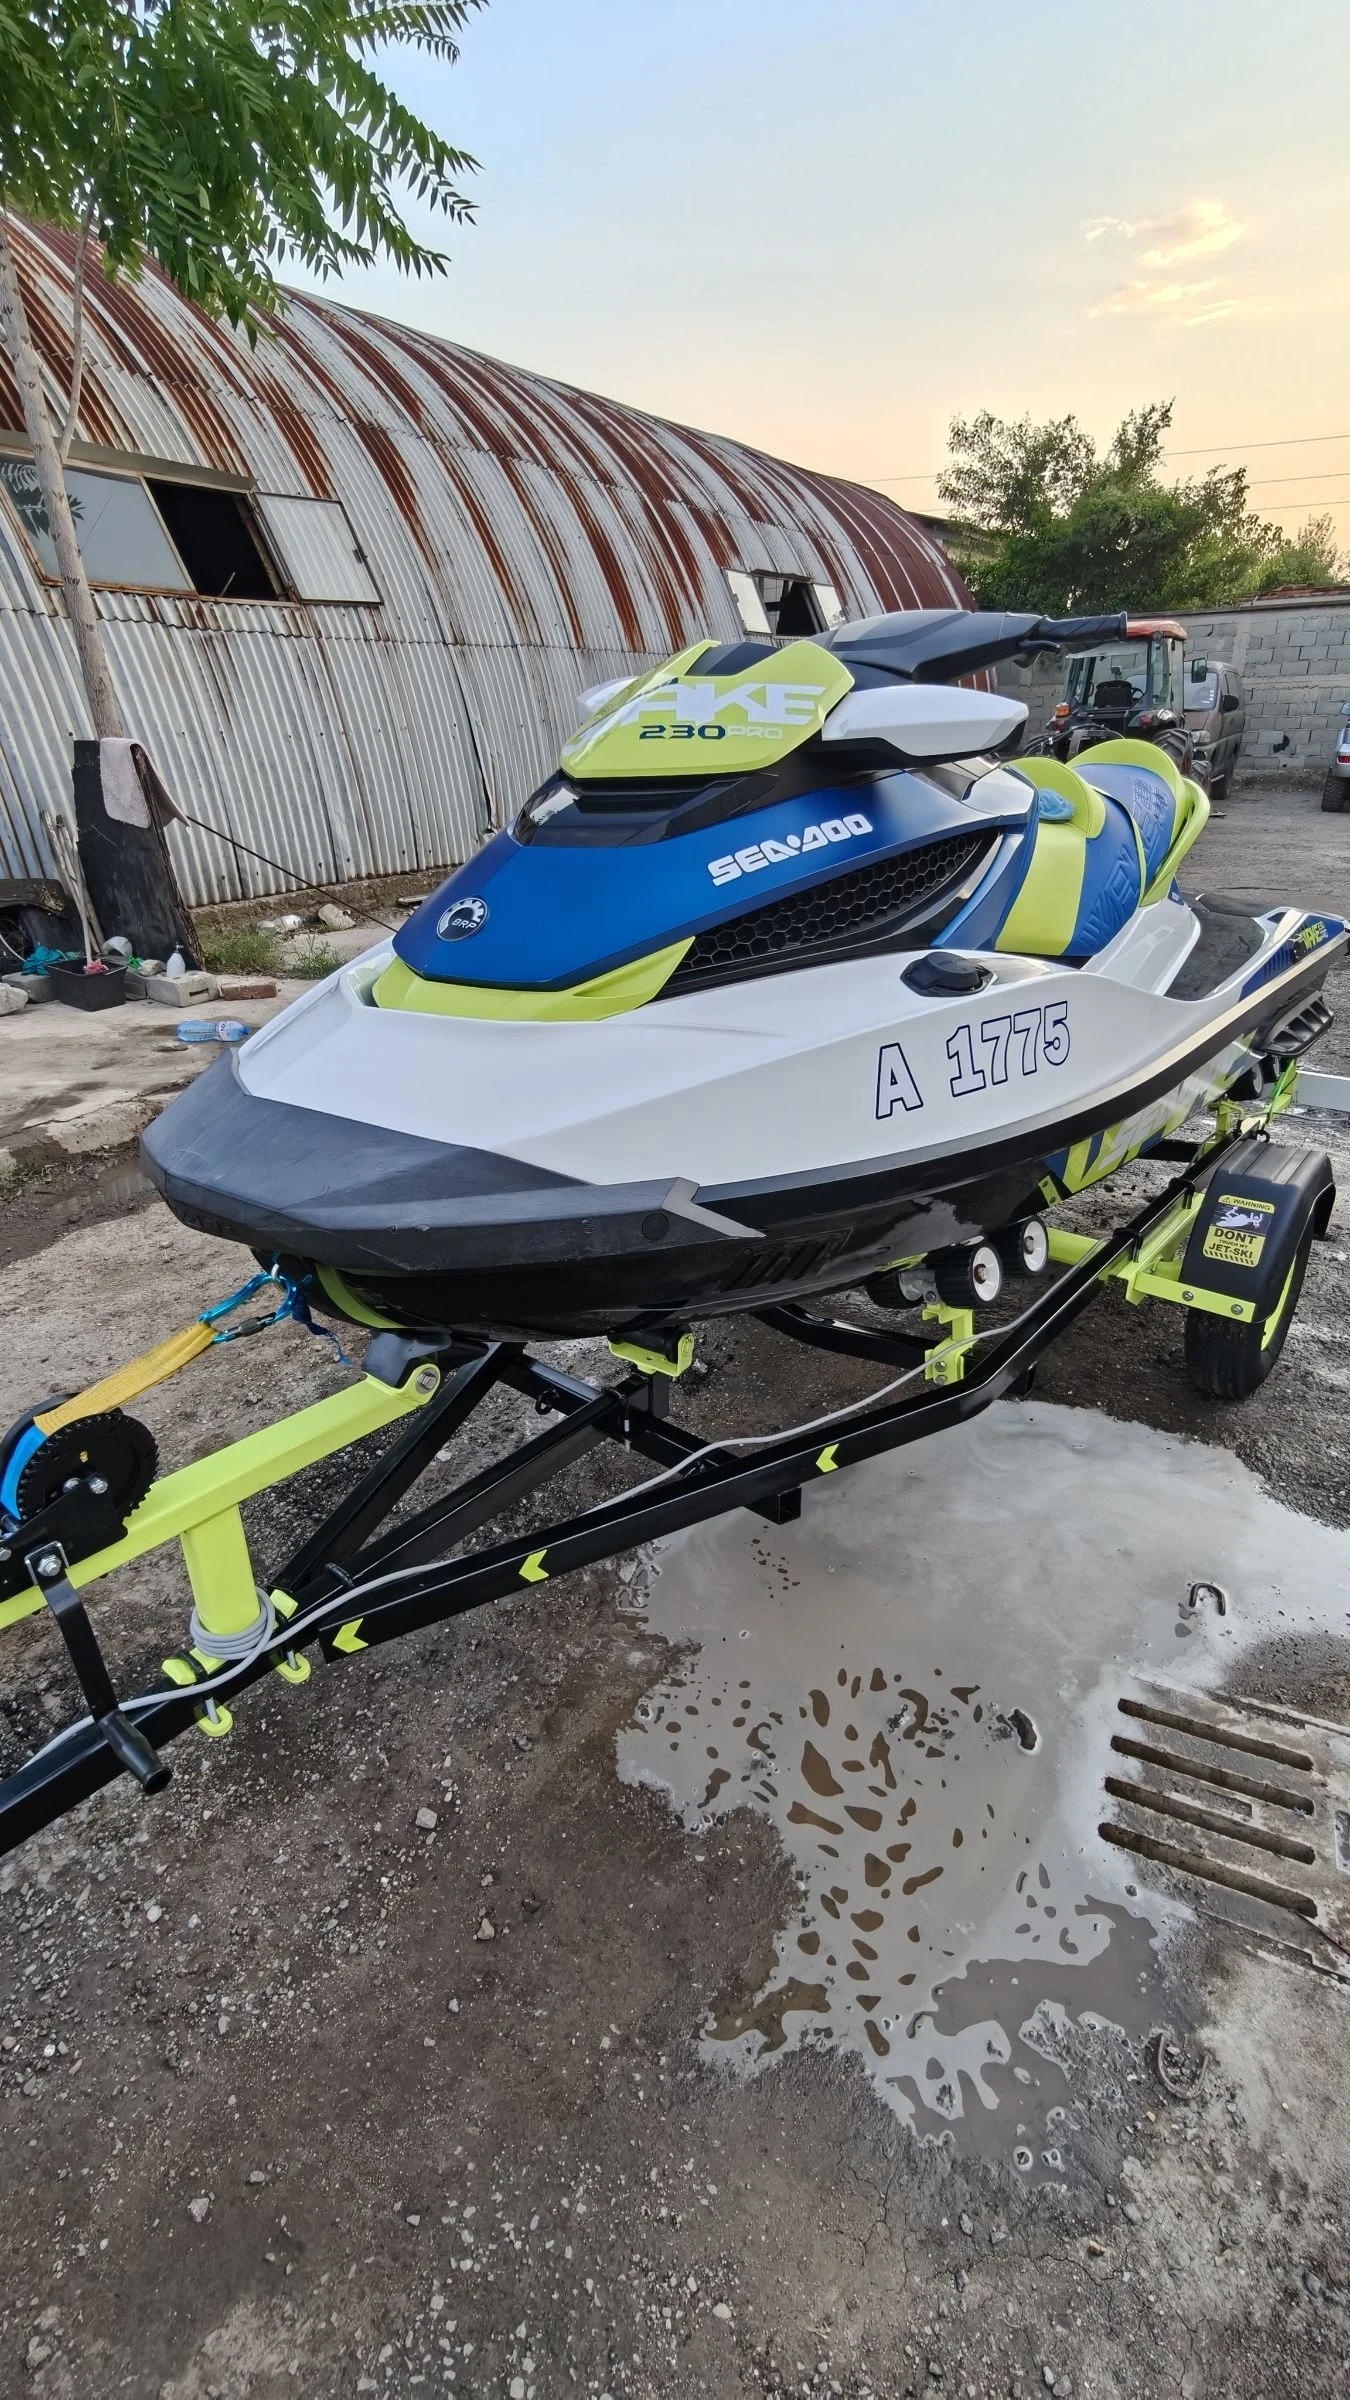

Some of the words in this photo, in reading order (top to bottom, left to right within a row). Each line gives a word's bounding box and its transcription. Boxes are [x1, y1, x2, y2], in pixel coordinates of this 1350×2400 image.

[451, 918, 478, 929] BRP
[876, 1042, 924, 1120] A
[946, 1001, 1071, 1098] 1775
[1233, 1198, 1271, 1211] WARNING
[1214, 1228, 1258, 1245] DONT
[1220, 1239, 1239, 1248] TOUCH
[1209, 1243, 1254, 1259] JET-SKI
